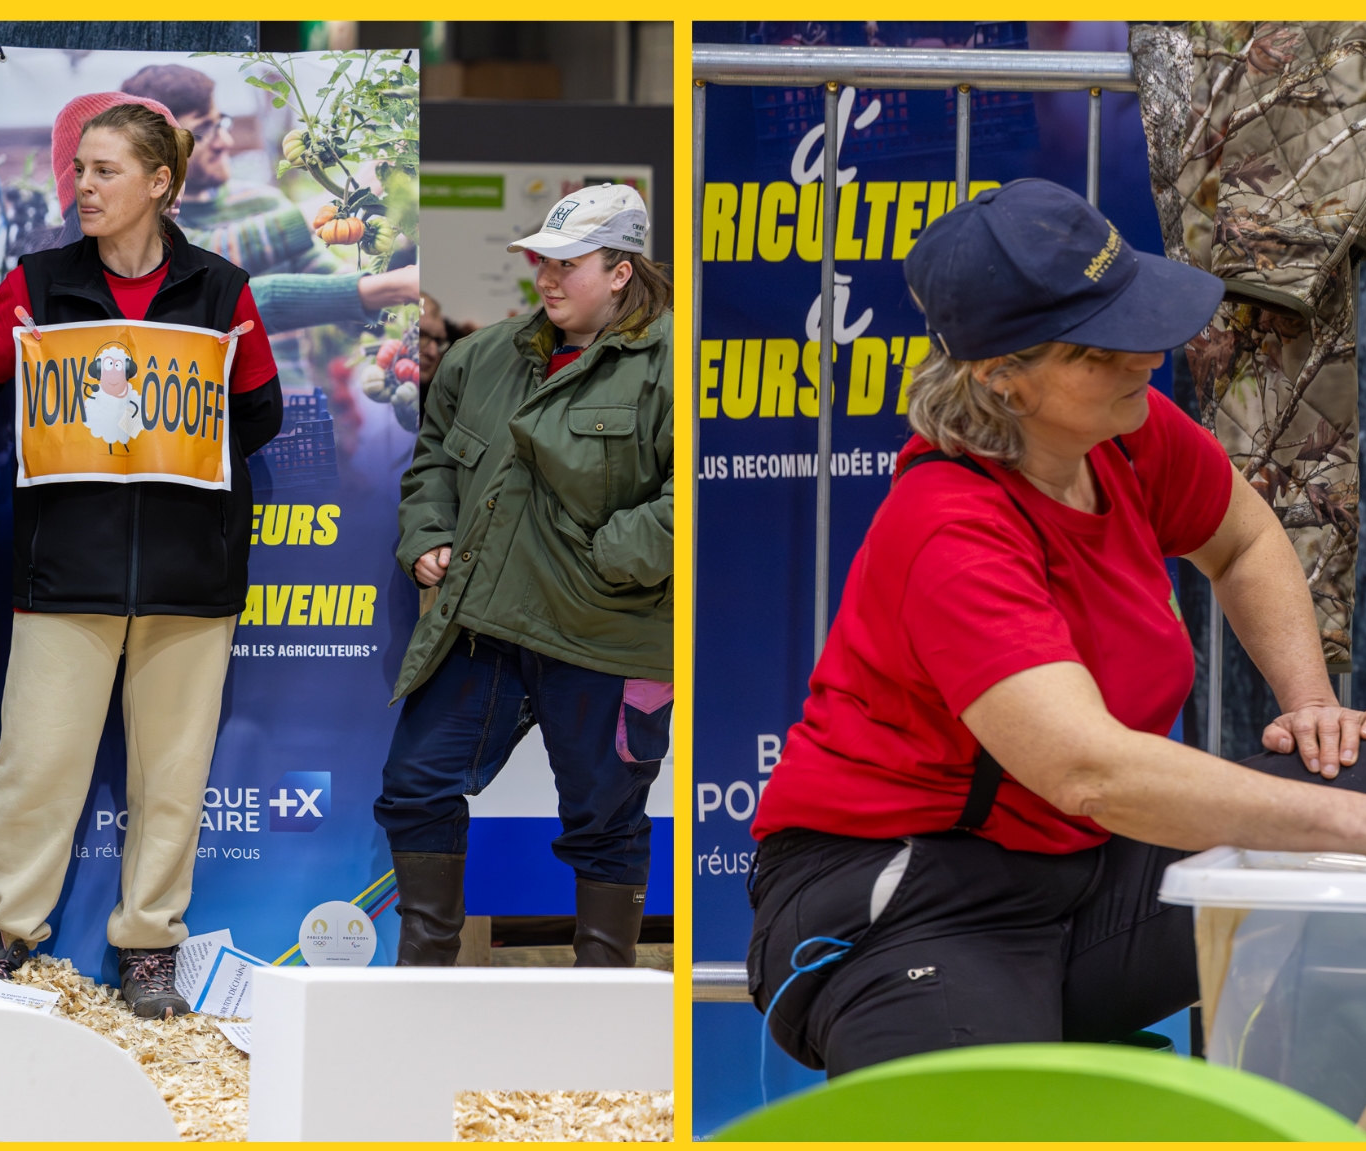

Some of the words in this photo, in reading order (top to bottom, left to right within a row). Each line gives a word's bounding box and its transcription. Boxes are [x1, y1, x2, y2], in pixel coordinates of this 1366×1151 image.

[702, 181, 1001, 262] RICULTE
[23, 356, 87, 428] VOIX
[141, 355, 224, 441] ÔÔÔFF
[698, 455, 729, 479] US
[239, 585, 377, 626] AVENIR
[253, 645, 275, 657] LES
[697, 780, 768, 823] PO
[75, 843, 90, 858] la
[197, 847, 217, 859] en
[222, 847, 260, 859] vous
